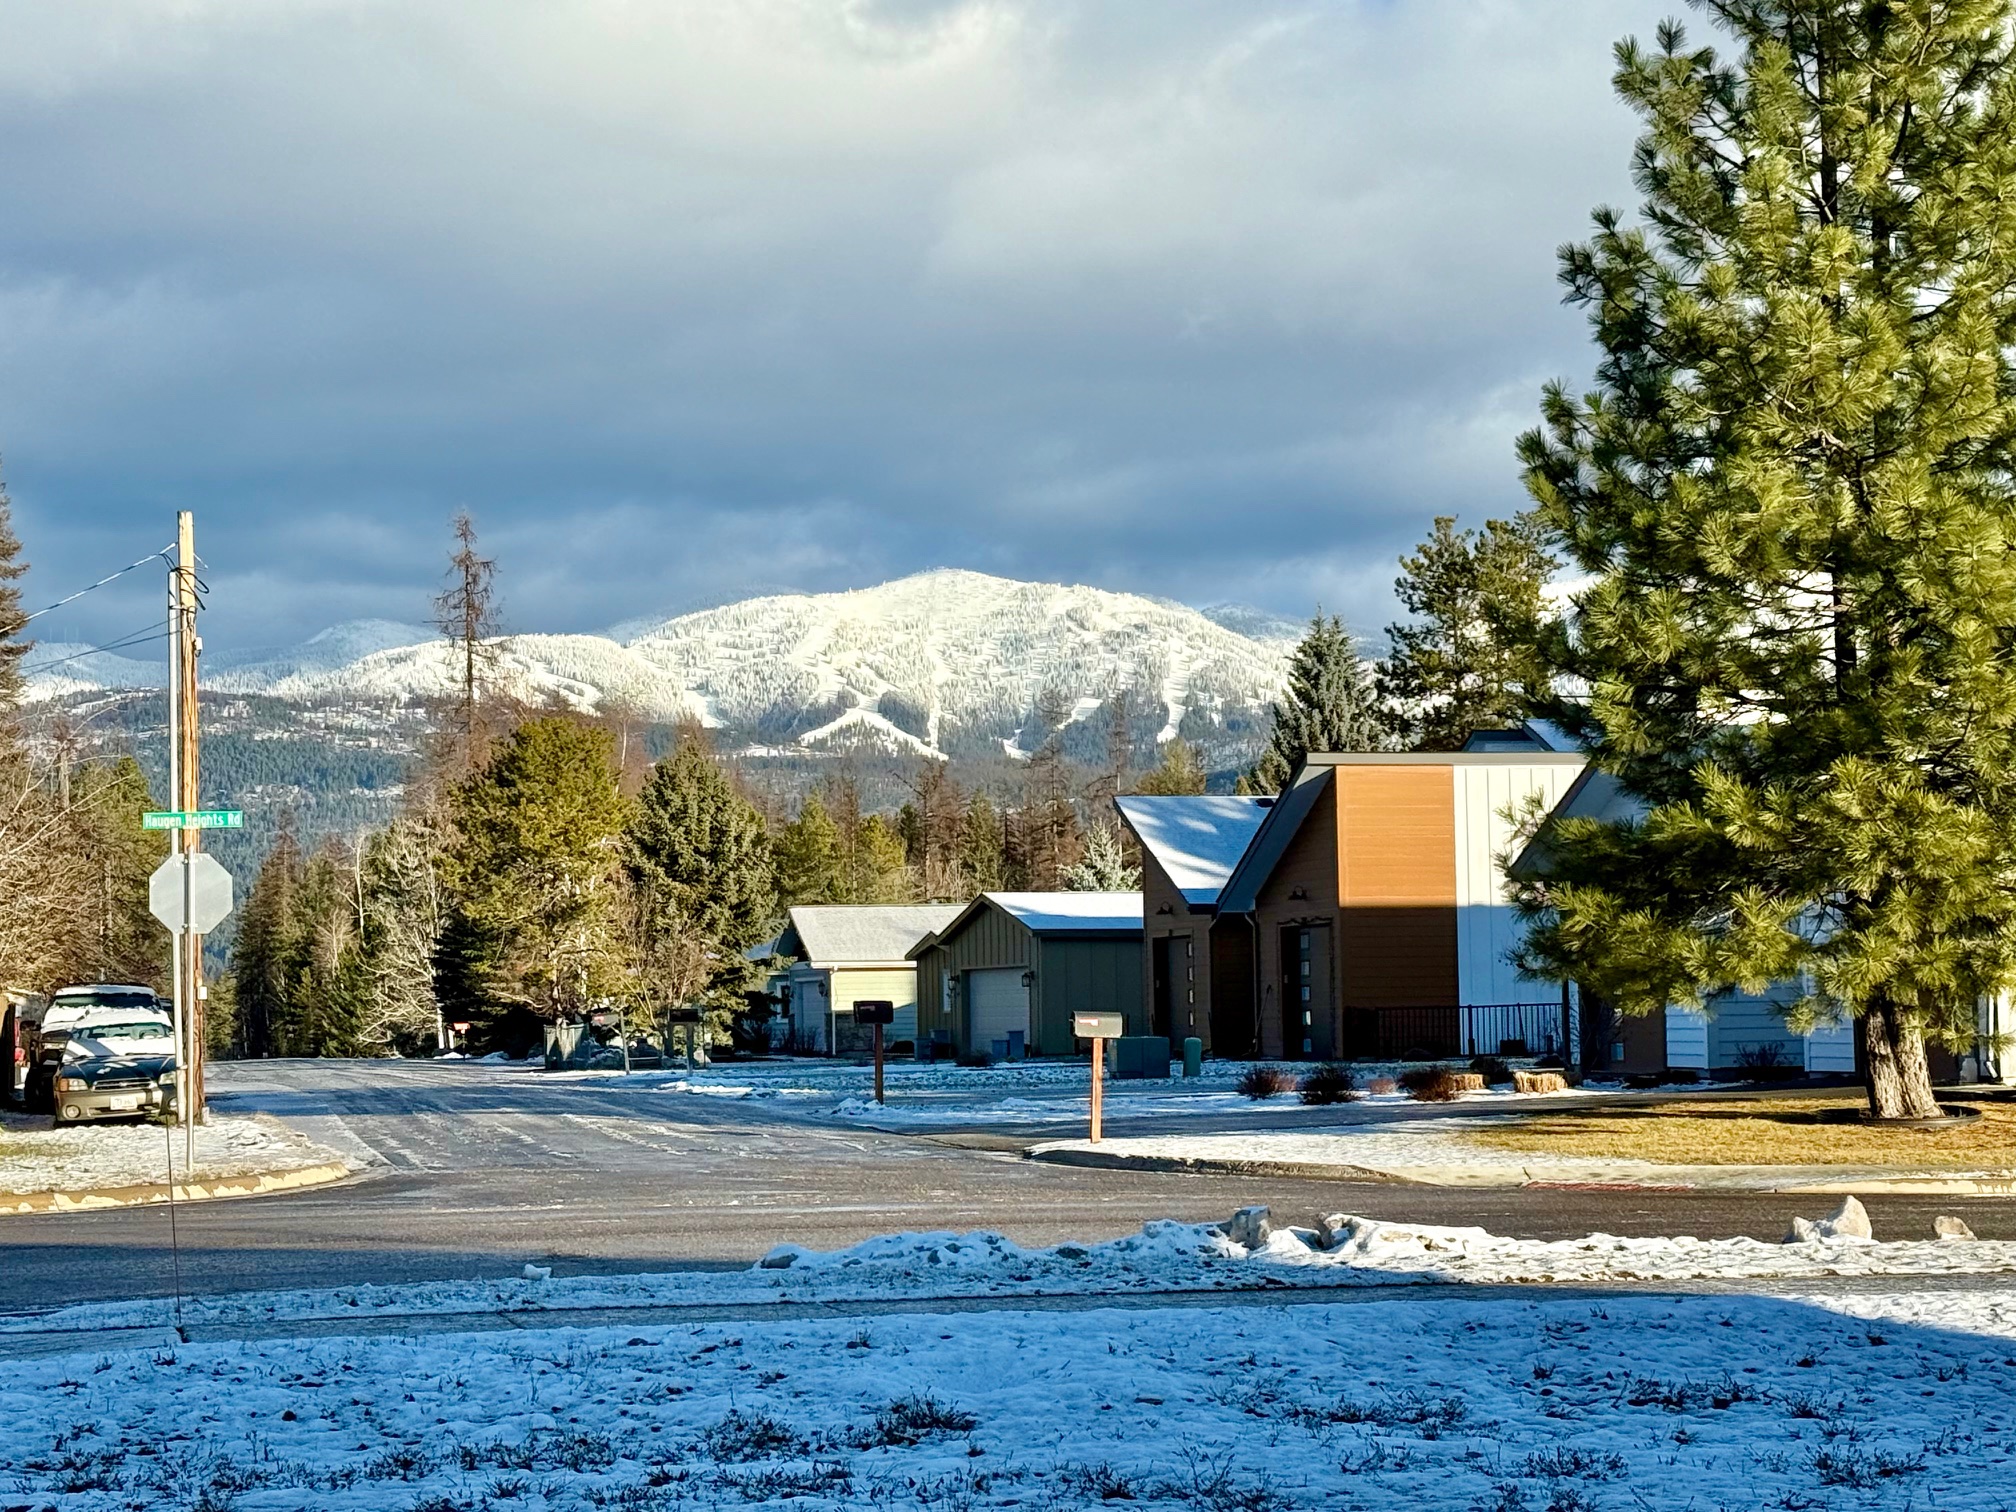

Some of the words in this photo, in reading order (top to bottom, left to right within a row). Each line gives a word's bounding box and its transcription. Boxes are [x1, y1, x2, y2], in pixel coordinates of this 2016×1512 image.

[145, 814, 182, 829] Haugen
[185, 813, 224, 828] Heights
[227, 813, 241, 825] Rd
